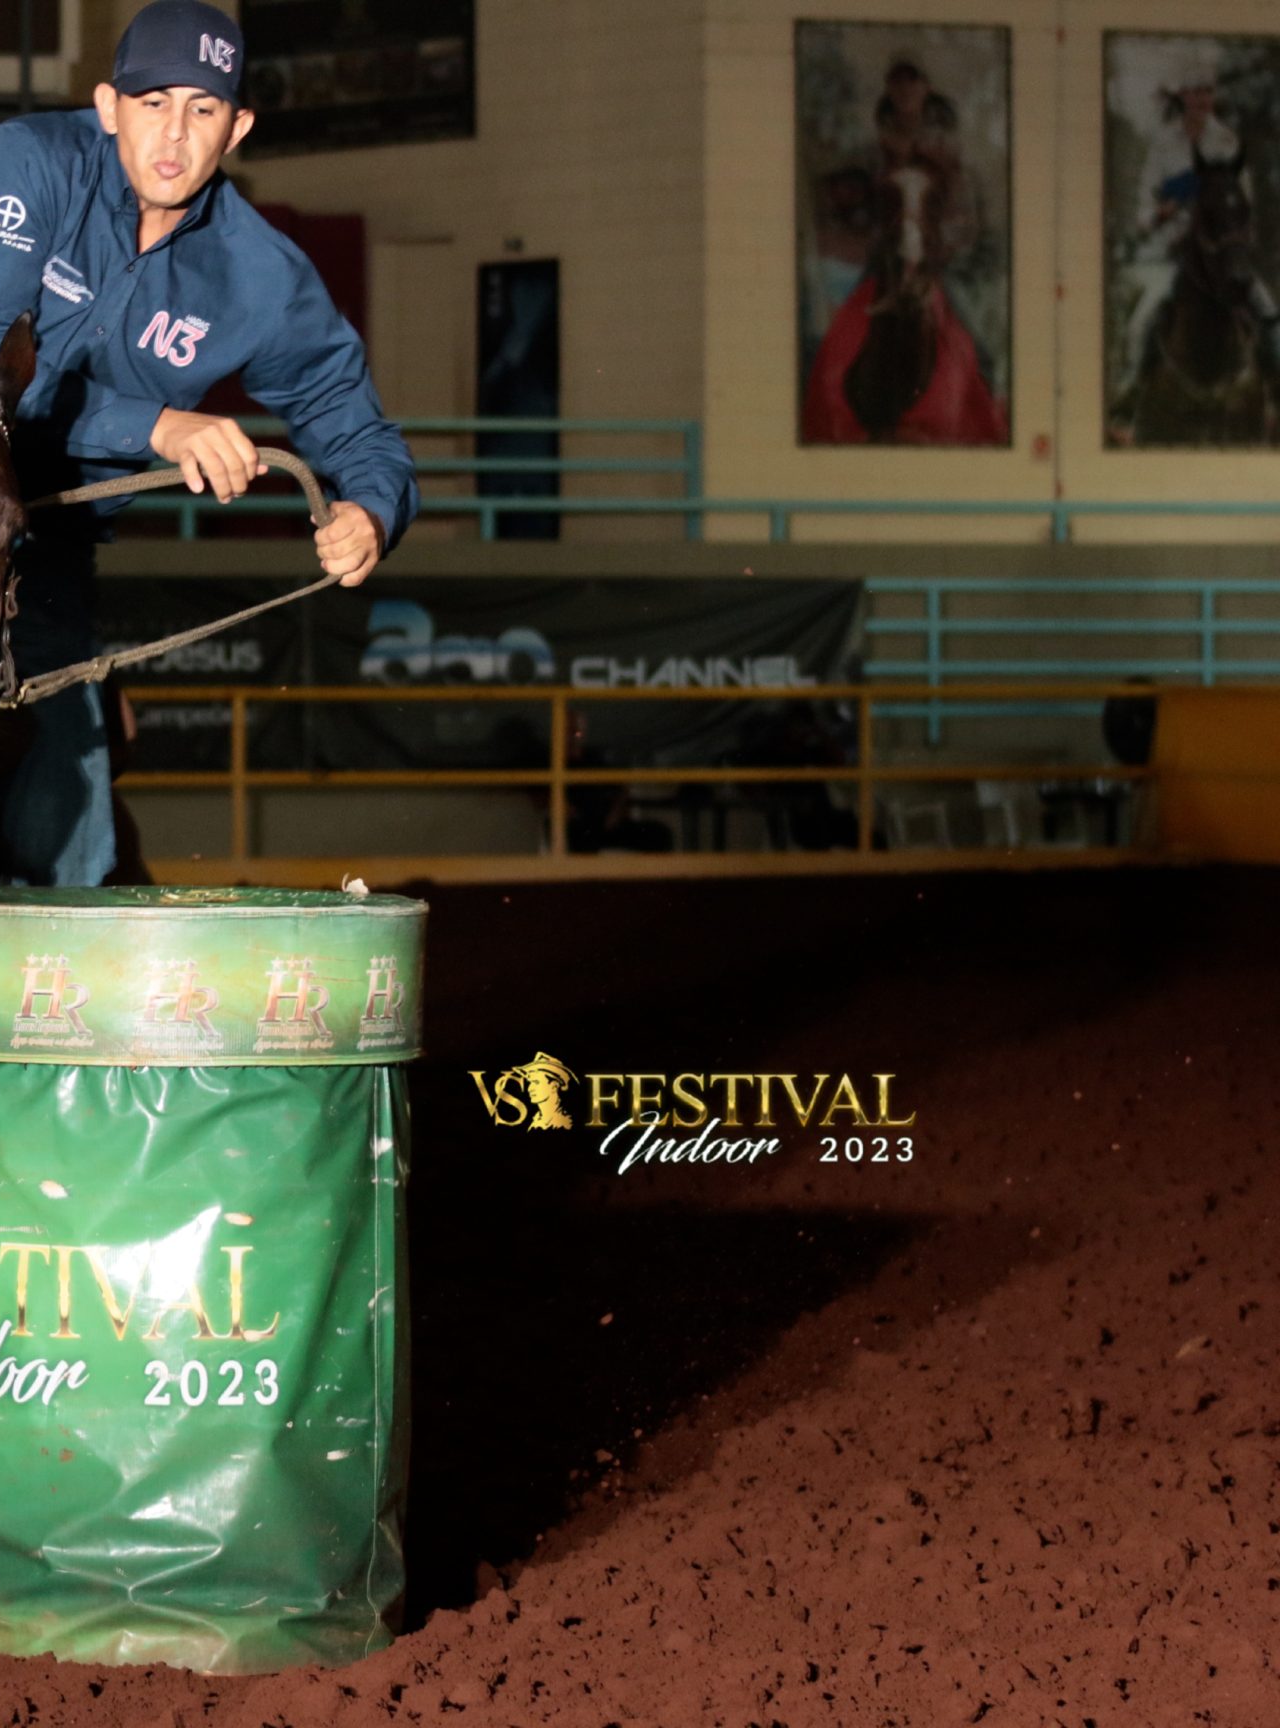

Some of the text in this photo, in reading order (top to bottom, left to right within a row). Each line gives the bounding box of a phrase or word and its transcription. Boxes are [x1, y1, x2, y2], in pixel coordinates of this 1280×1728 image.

[199, 33, 236, 73] N3
[137, 310, 206, 367] N3
[569, 654, 819, 689] CHANNEL
[16, 965, 94, 1037] HR
[257, 969, 334, 1039] HR
[143, 1359, 280, 1406] 2023
